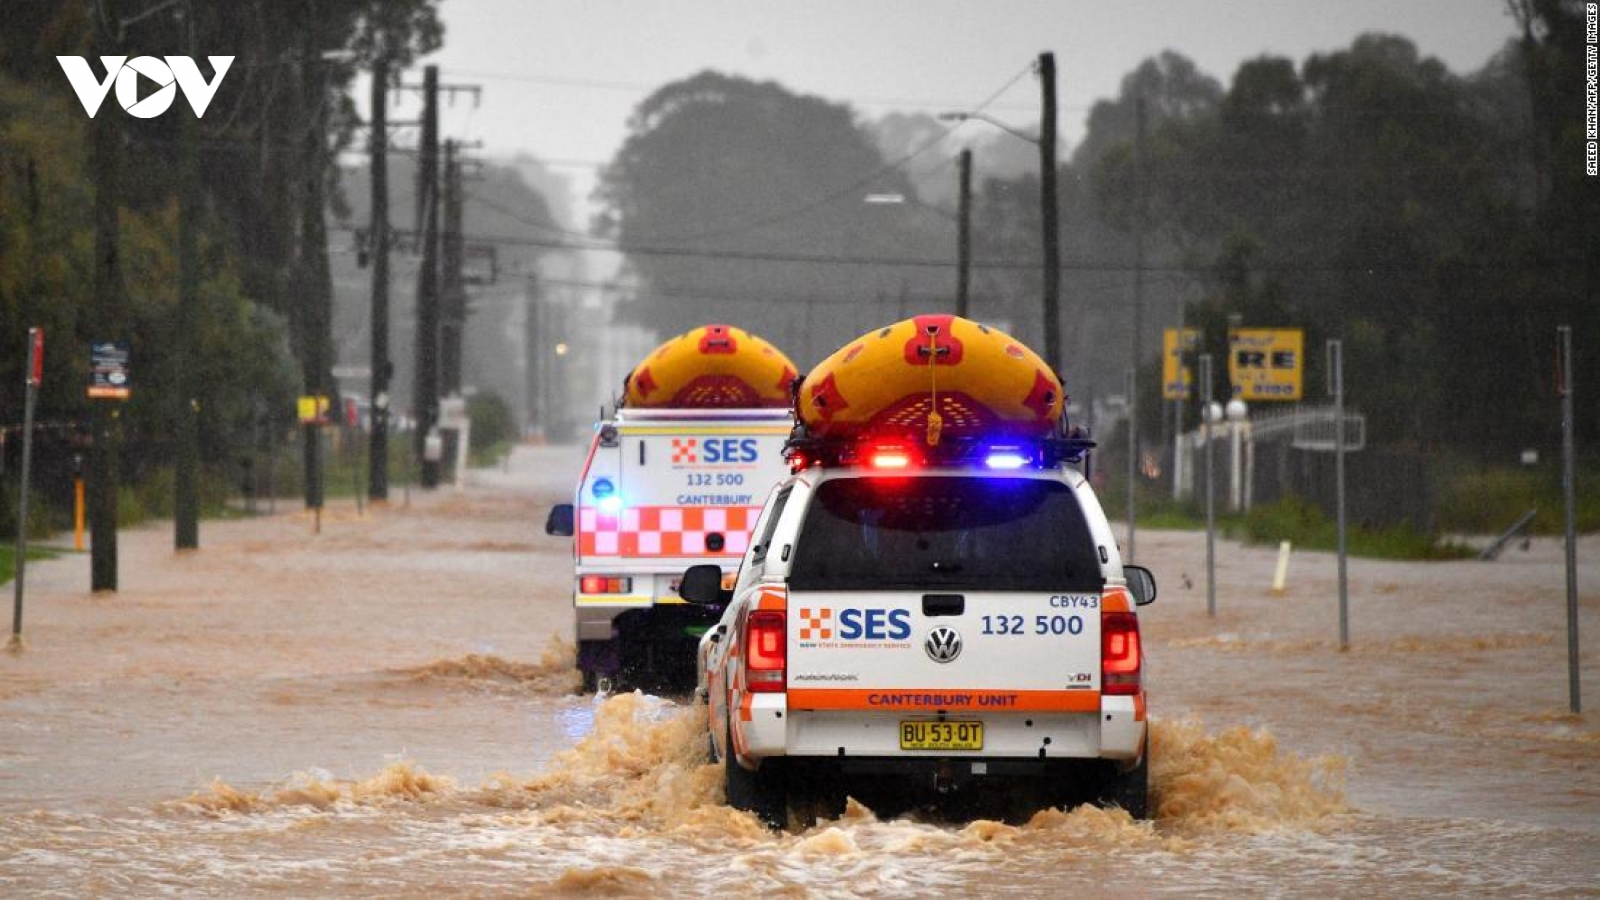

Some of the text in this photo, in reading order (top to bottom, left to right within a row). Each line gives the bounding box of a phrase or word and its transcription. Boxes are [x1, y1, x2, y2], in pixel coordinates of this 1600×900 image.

[703, 439, 758, 463] SES
[687, 474, 744, 486] 132 500
[676, 494, 753, 505] CANTERBURY
[1049, 595, 1098, 609] CBY43
[840, 608, 911, 640] SES
[982, 615, 1083, 635] 132 500
[868, 694, 1018, 706] CANTERBURY UNIT
